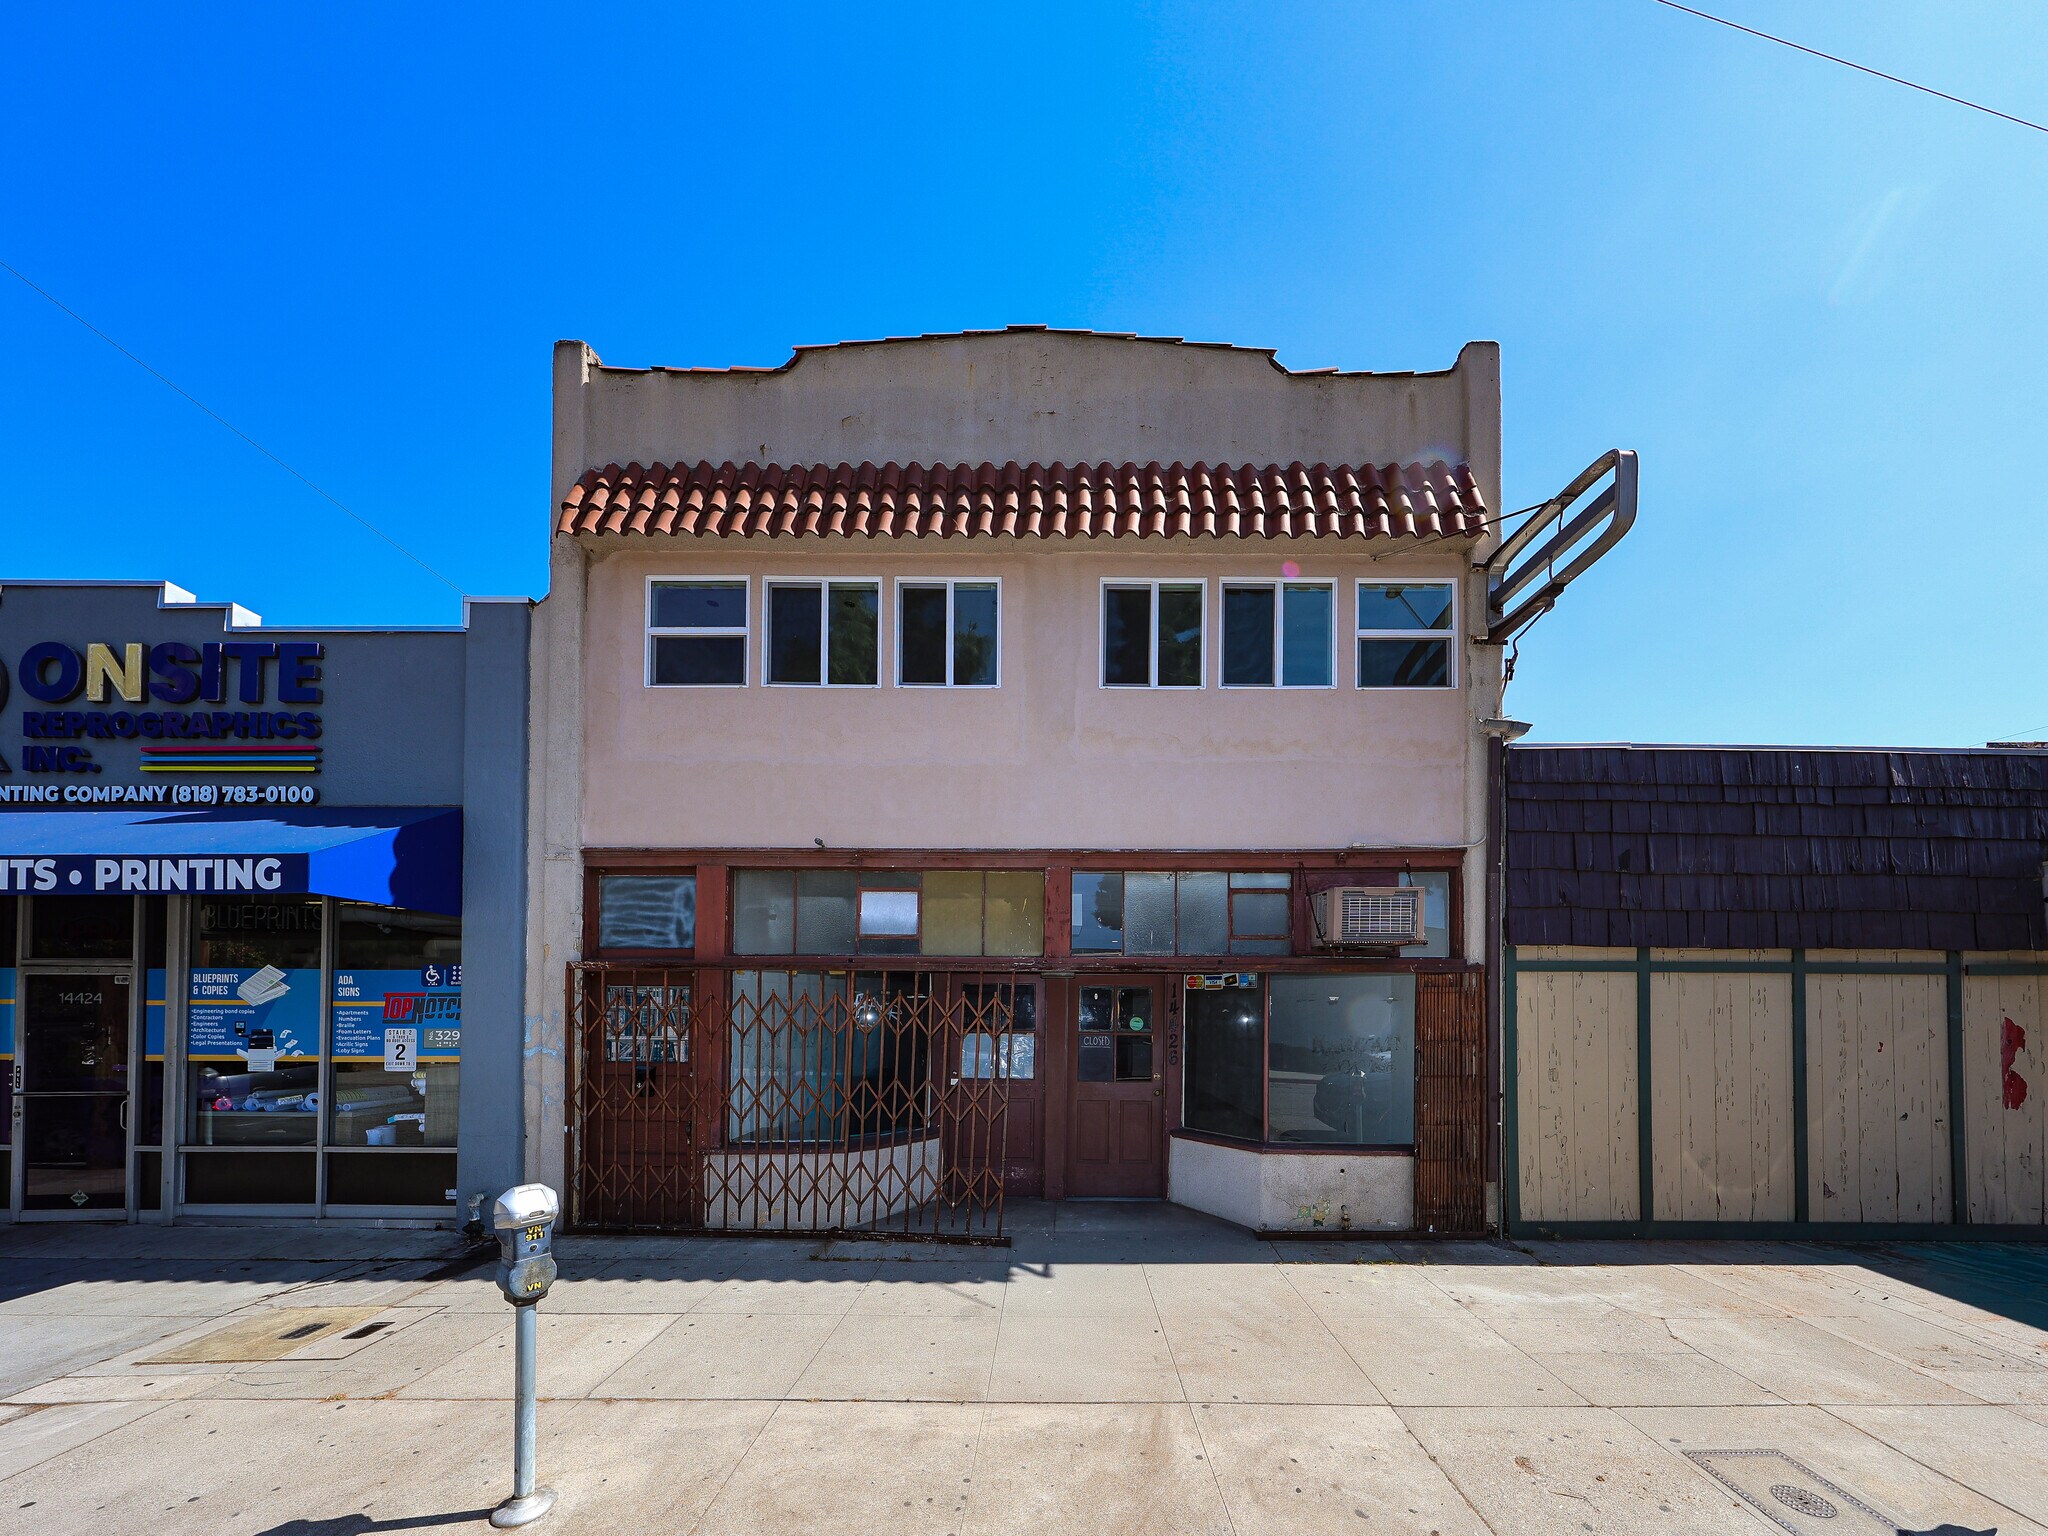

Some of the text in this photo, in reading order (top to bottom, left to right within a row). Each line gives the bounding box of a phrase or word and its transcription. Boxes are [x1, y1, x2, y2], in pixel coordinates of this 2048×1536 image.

[18, 641, 325, 704] ONSITE
[23, 711, 322, 738] REPROGRAPHICS
[22, 745, 101, 773] INC.
[64, 785, 167, 802] COMPANY
[172, 785, 218, 804] (818)
[222, 785, 314, 802] 783-0100
[0, 858, 282, 891] TS PRINTING
[193, 973, 239, 983] BLUEPRINTS
[338, 975, 353, 985] ADA
[202, 985, 228, 995] COPIES
[338, 987, 360, 997] SIGNS
[58, 992, 102, 1005] 14424
[435, 1030, 460, 1040] 329
[1084, 1036, 1110, 1046] CLOSED
[396, 1044, 406, 1060] 2
[528, 1225, 542, 1234] VN
[526, 1232, 544, 1240] 911
[528, 1282, 542, 1291] VN
